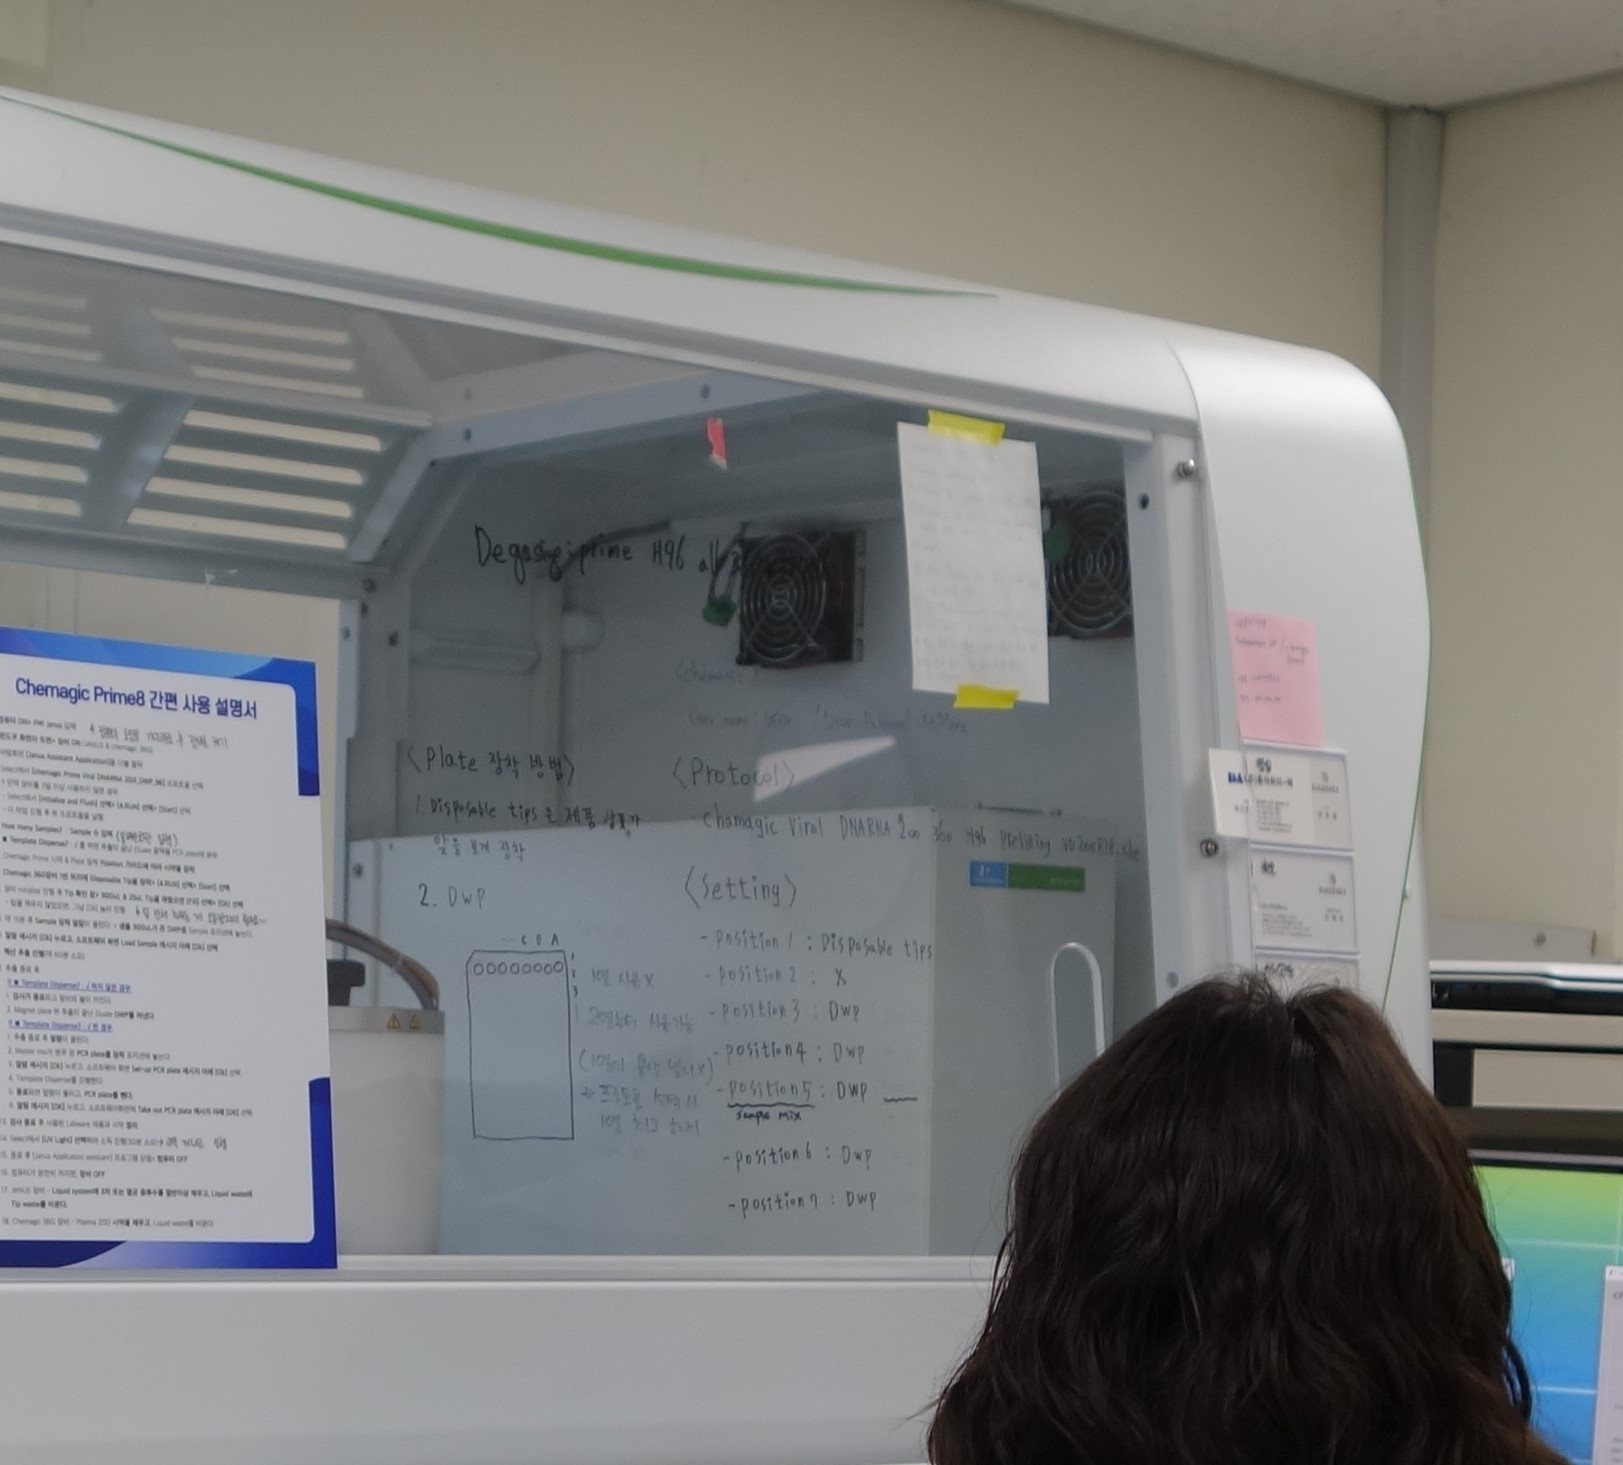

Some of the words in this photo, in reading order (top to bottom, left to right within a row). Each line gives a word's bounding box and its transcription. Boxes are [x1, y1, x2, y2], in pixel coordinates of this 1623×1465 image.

[16, 677, 90, 705] Chemagic
[94, 685, 145, 707] Prime8
[149, 690, 178, 712] 간편
[183, 693, 211, 716] 사용
[215, 696, 258, 720] 설명서
[508, 802, 538, 825] tips
[904, 936, 933, 960] tips
